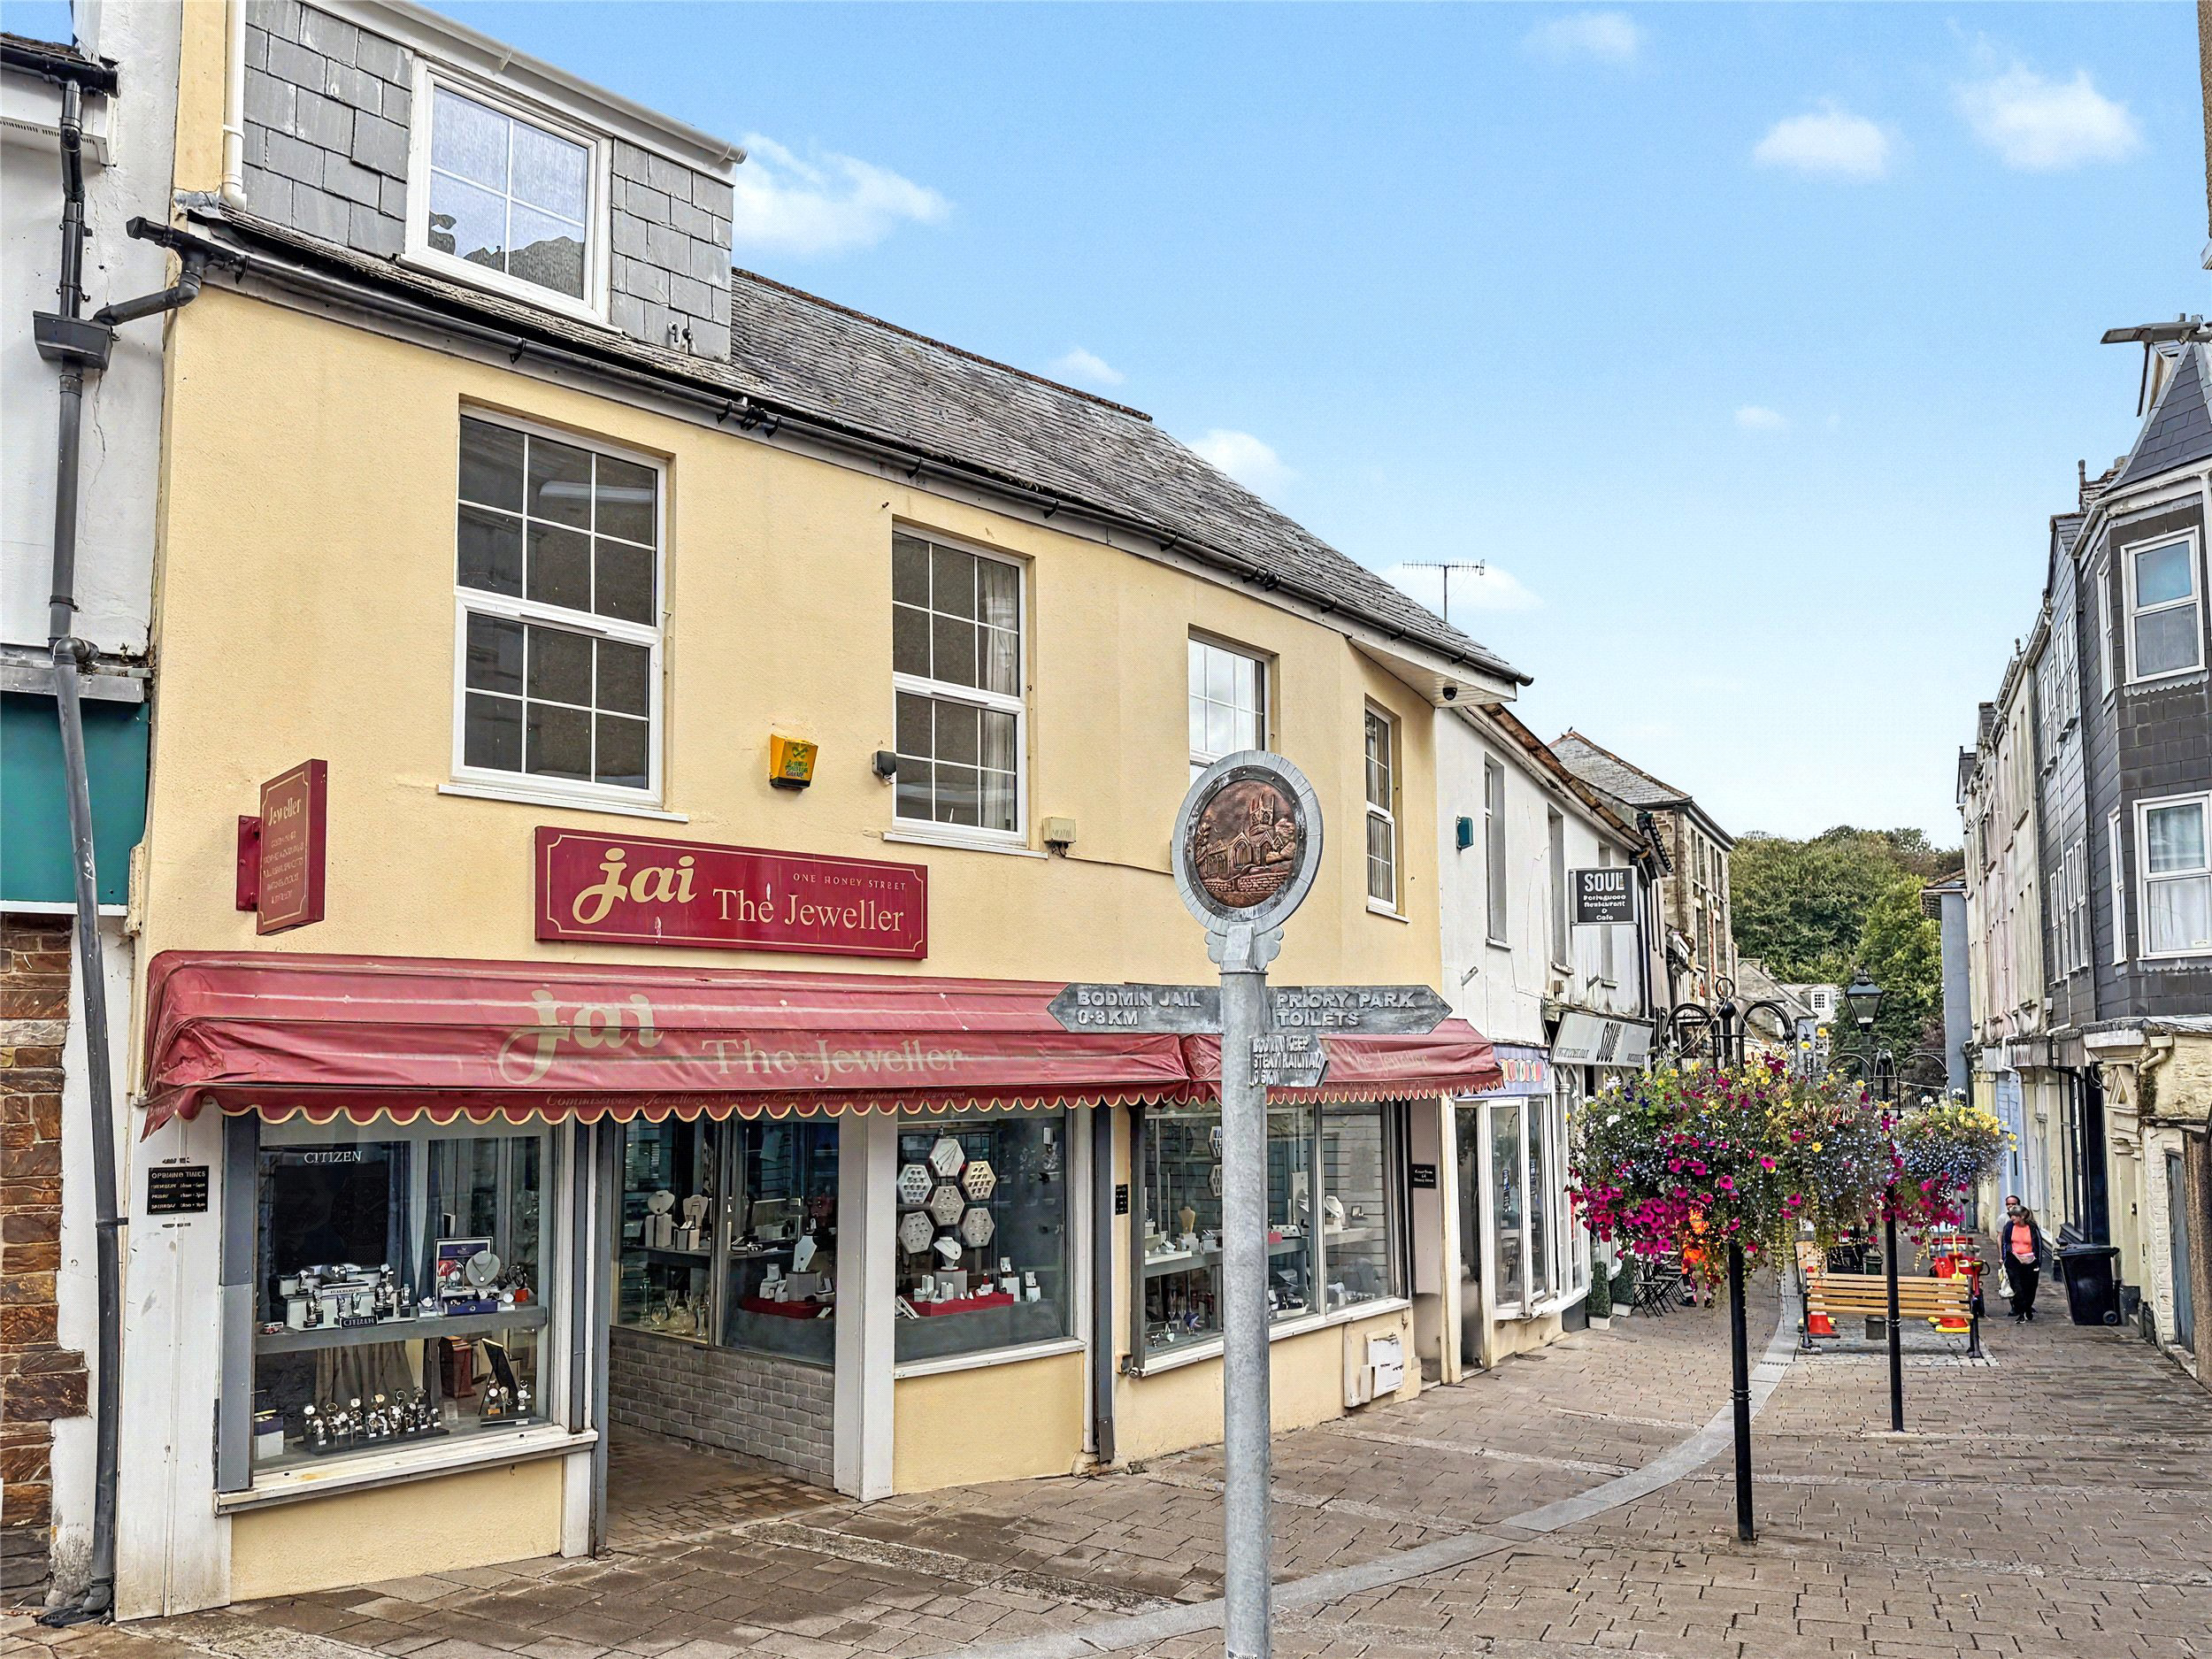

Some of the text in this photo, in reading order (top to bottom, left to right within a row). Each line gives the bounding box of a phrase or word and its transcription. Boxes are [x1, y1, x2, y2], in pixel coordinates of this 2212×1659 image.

[268, 797, 302, 826] Jeweller
[572, 848, 698, 925] jai
[793, 872, 906, 891] ONE HONEY STREET
[1584, 872, 1624, 892] SOUL
[712, 887, 904, 932] The Jeweller
[1078, 991, 1201, 1007] BODMIN JAIL
[1276, 992, 1416, 1009] PRIORY PARK
[1277, 1010, 1360, 1027] TOILETS
[498, 990, 664, 1085] jai
[702, 1039, 963, 1083] The Jeweller
[304, 1151, 363, 1164] CITIZEN
